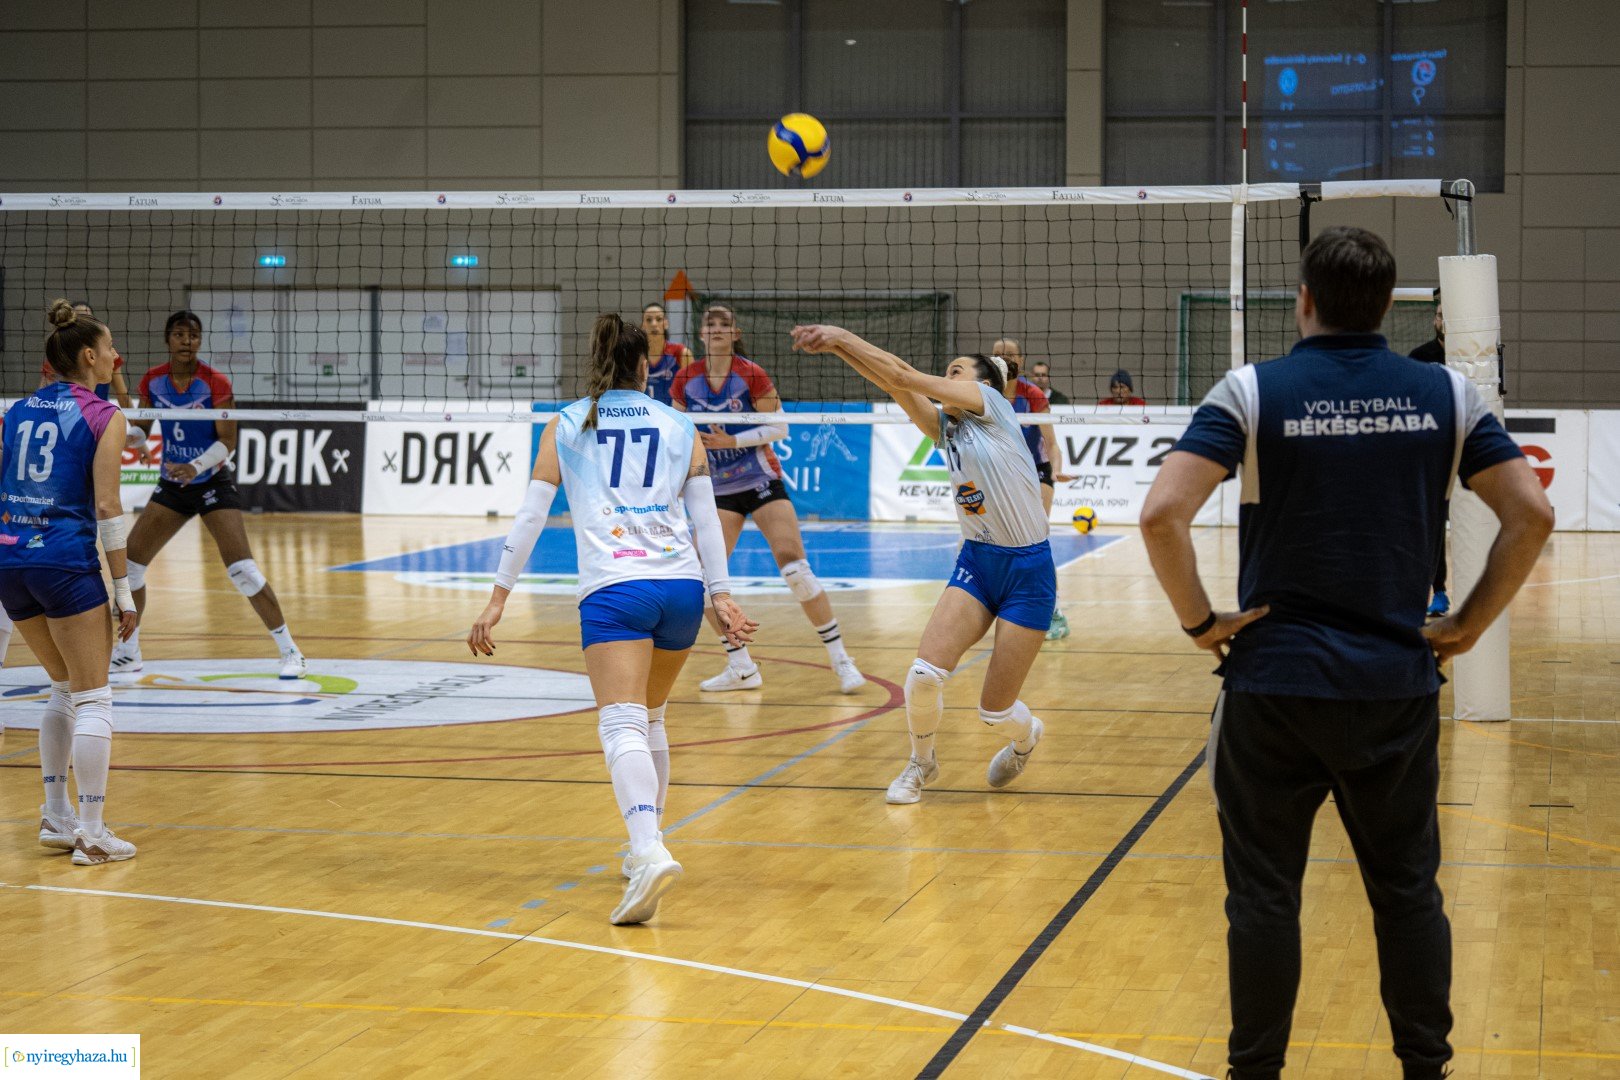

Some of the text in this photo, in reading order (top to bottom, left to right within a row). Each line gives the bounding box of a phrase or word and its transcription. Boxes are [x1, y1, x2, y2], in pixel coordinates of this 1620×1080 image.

[128, 196, 159, 206] FATUM
[351, 195, 382, 205] FATUM
[579, 194, 611, 204] FATUM
[813, 192, 845, 203] FATUM
[1052, 190, 1085, 201] FATUM
[598, 406, 650, 418] PASKOVA
[1303, 397, 1417, 415] VOLLEYBALL
[1283, 413, 1438, 437] BÉKÉSCSABA
[172, 421, 185, 442] 6
[16, 420, 59, 483] 13
[596, 427, 660, 488] 77
[8, 494, 55, 506] sportmarket
[957, 567, 974, 584] 17
